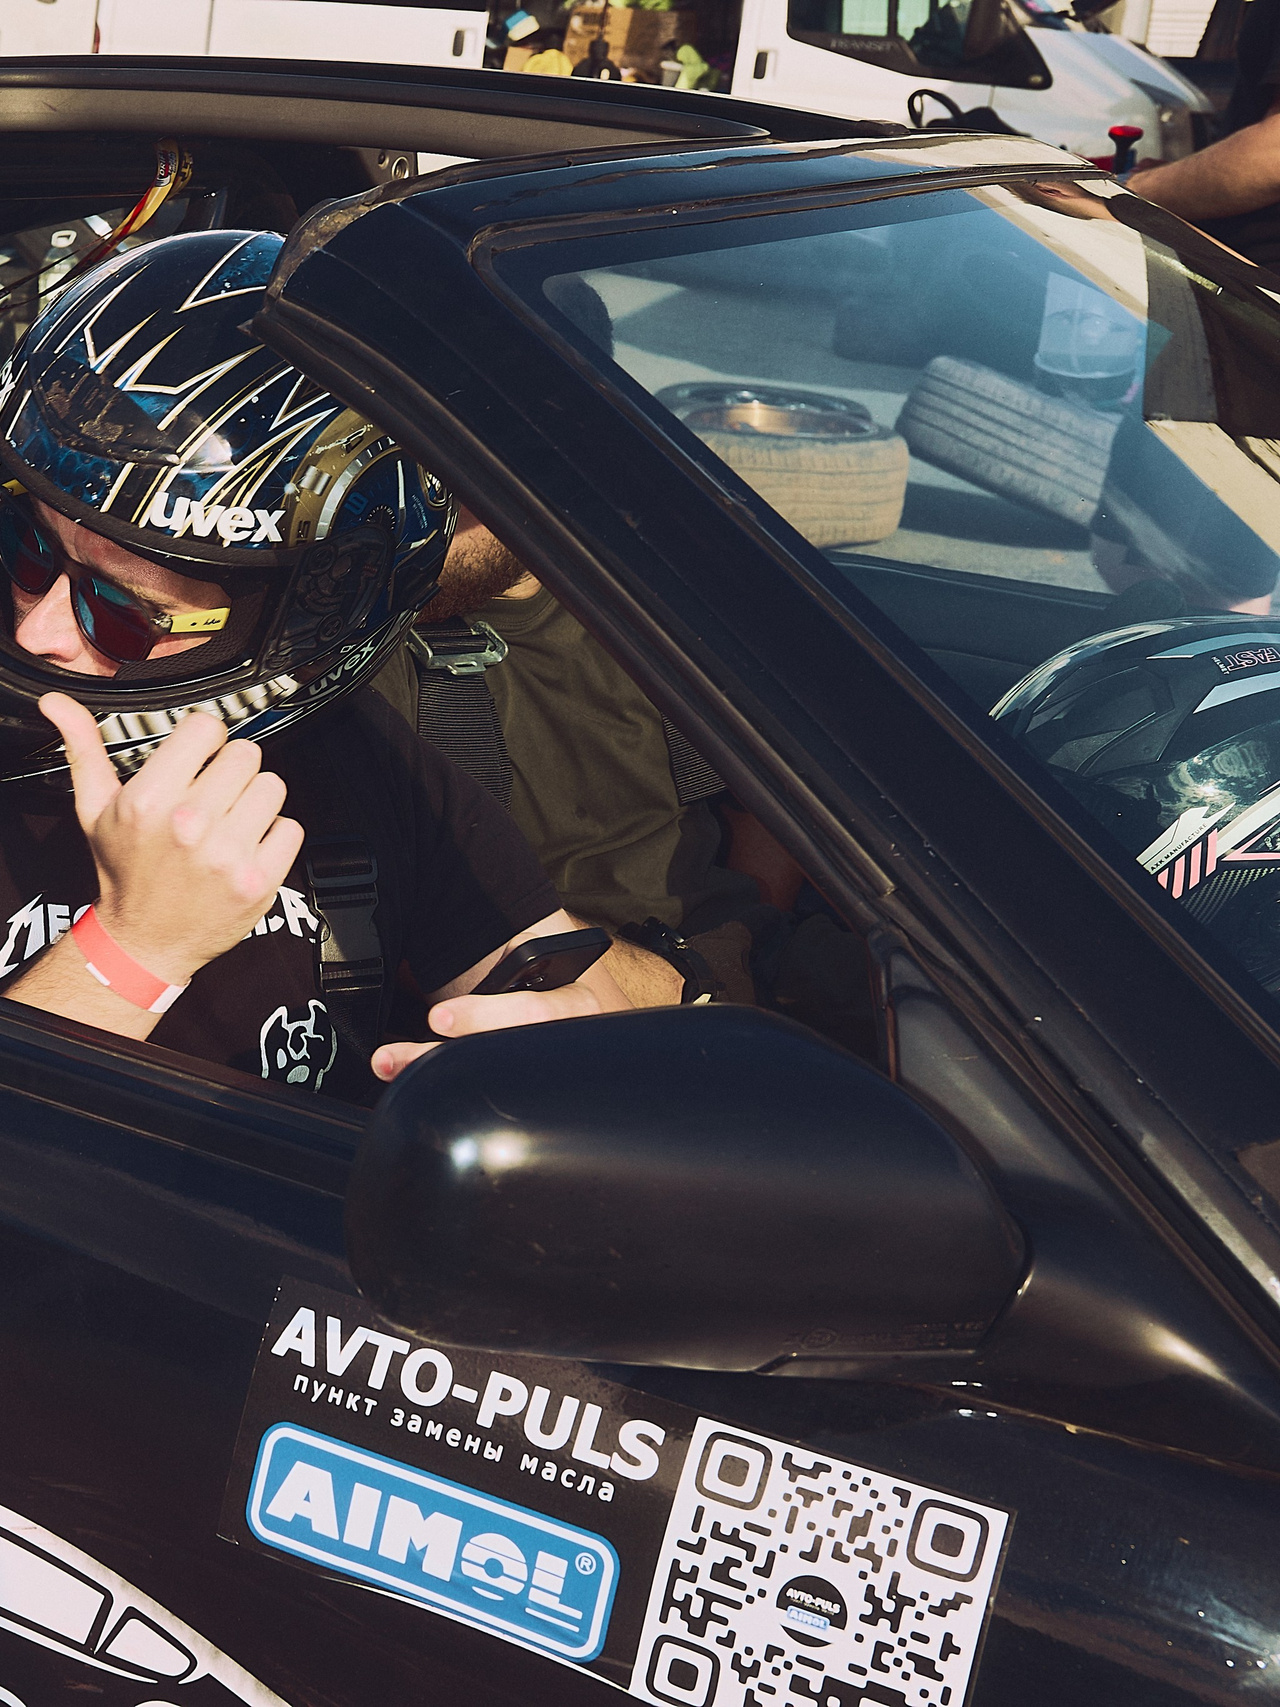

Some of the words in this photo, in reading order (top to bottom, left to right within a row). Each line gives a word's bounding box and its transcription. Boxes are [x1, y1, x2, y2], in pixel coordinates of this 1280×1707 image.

[149, 490, 287, 542] uvex
[308, 640, 375, 696] uvex
[1224, 646, 1280, 672] FAST
[1164, 823, 1208, 861] MANUFACTURE
[271, 1306, 666, 1481] AVTO-PULS
[293, 1374, 378, 1416] пункт
[390, 1408, 504, 1463] замены
[520, 1453, 615, 1502] масла
[786, 1587, 841, 1614] AVTO-PULS
